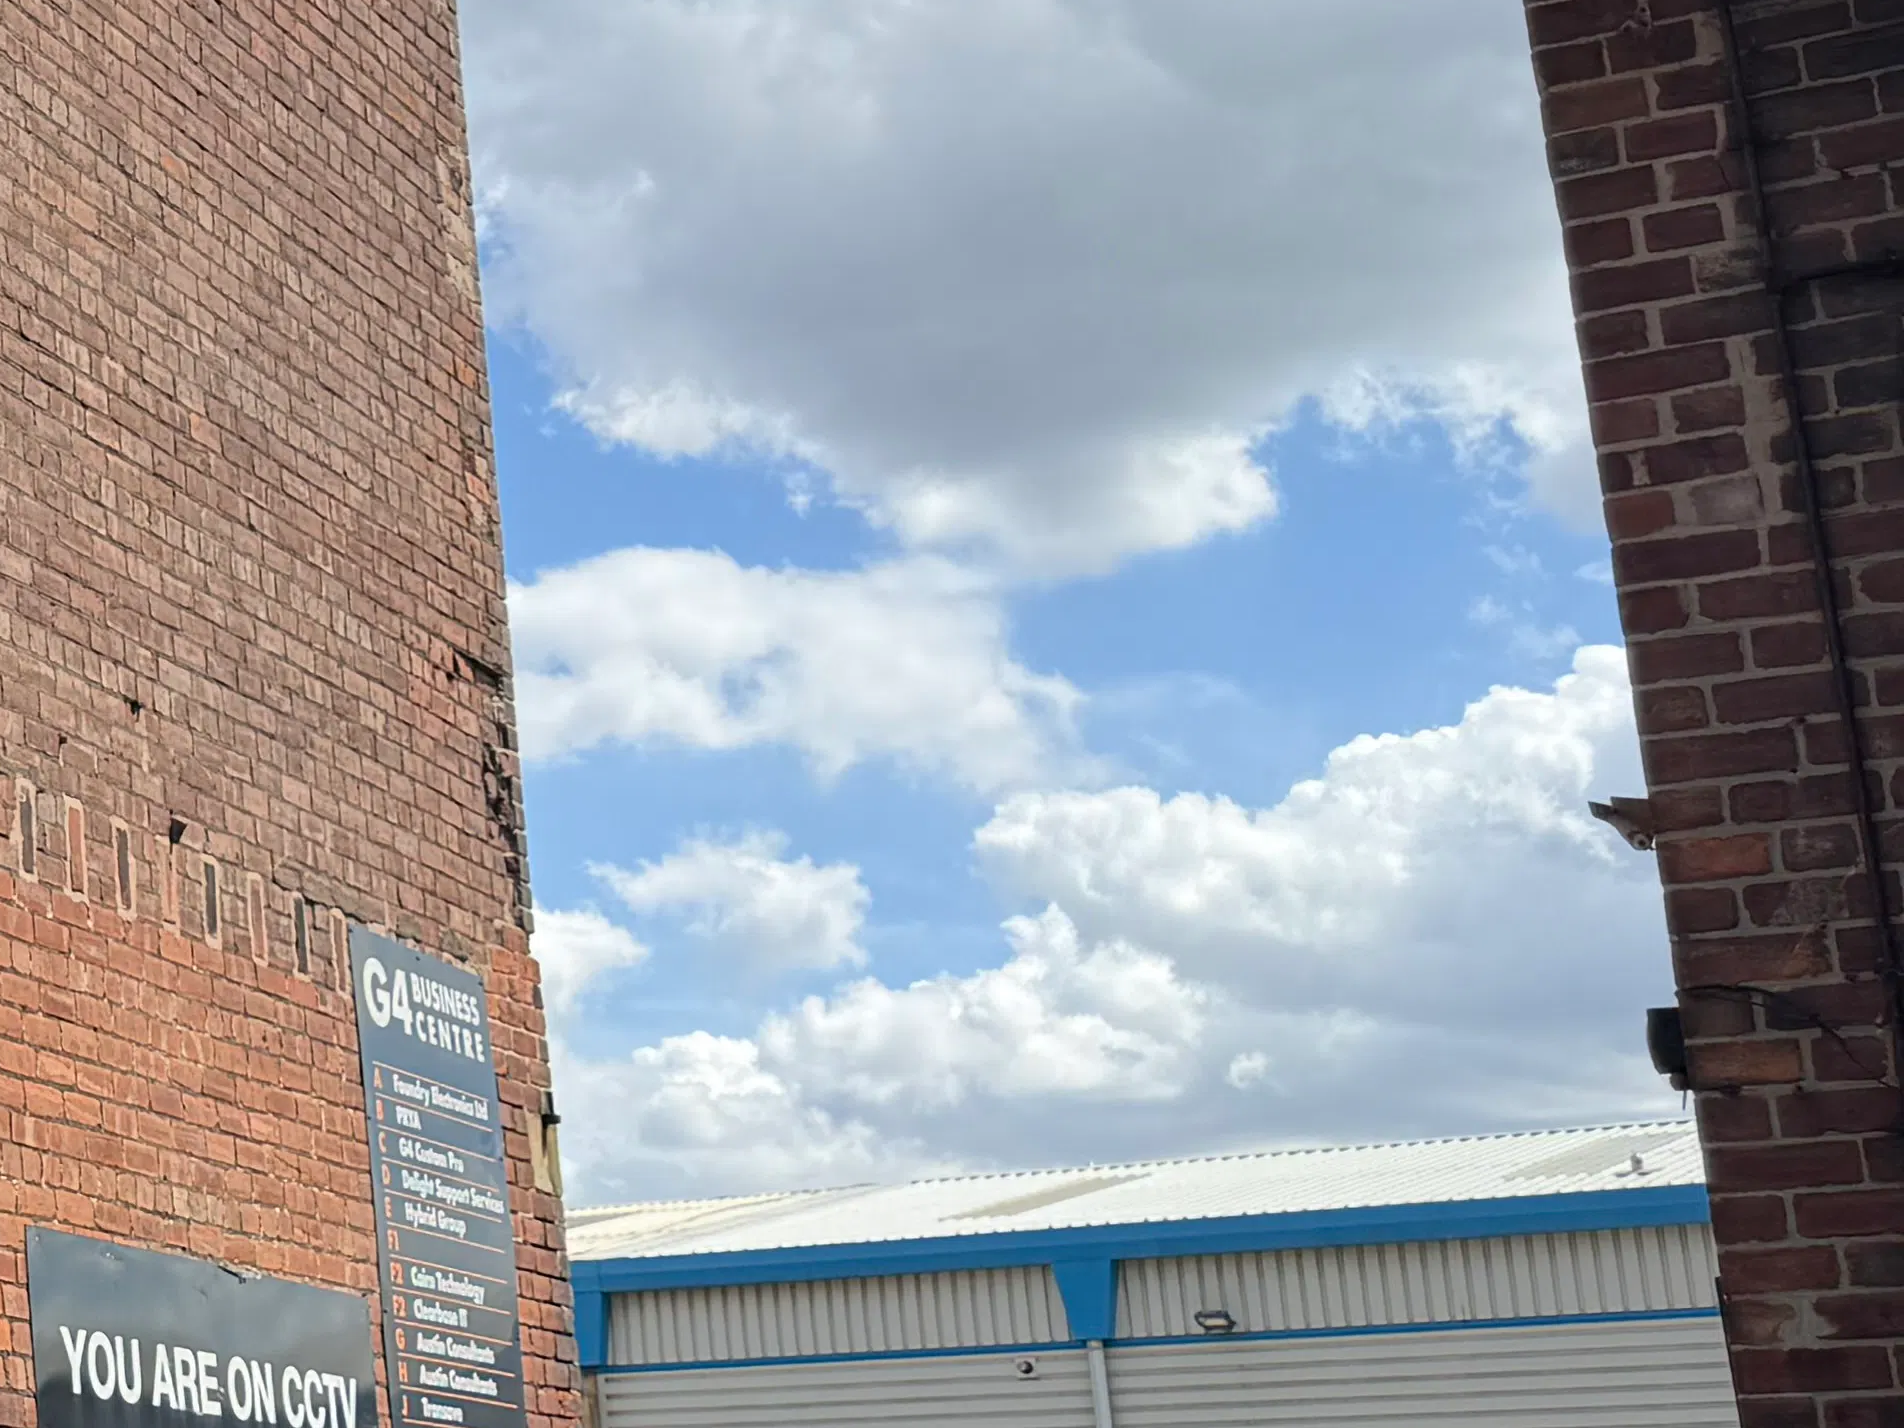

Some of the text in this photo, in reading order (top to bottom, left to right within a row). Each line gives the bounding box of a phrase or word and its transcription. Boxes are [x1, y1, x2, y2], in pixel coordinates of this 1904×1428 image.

[363, 957, 481, 1036] G4 BUSINESS
[415, 1011, 486, 1063] CENTRE
[374, 1067, 383, 1089] A
[393, 1074, 430, 1107] Foundry
[376, 1099, 384, 1120] B
[378, 1131, 387, 1153] C
[399, 1137, 414, 1158] G4
[381, 1163, 391, 1185] D
[435, 1178, 470, 1206] Support
[470, 1188, 504, 1214] Services
[384, 1196, 467, 1239] E Hybrid Group
[390, 1262, 404, 1285] F2
[392, 1294, 406, 1317] F2
[395, 1327, 405, 1350] G
[59, 1325, 142, 1404] YOU
[152, 1343, 222, 1416] ARE
[227, 1355, 278, 1424] ON
[398, 1361, 409, 1383] H
[402, 1394, 409, 1416] J
